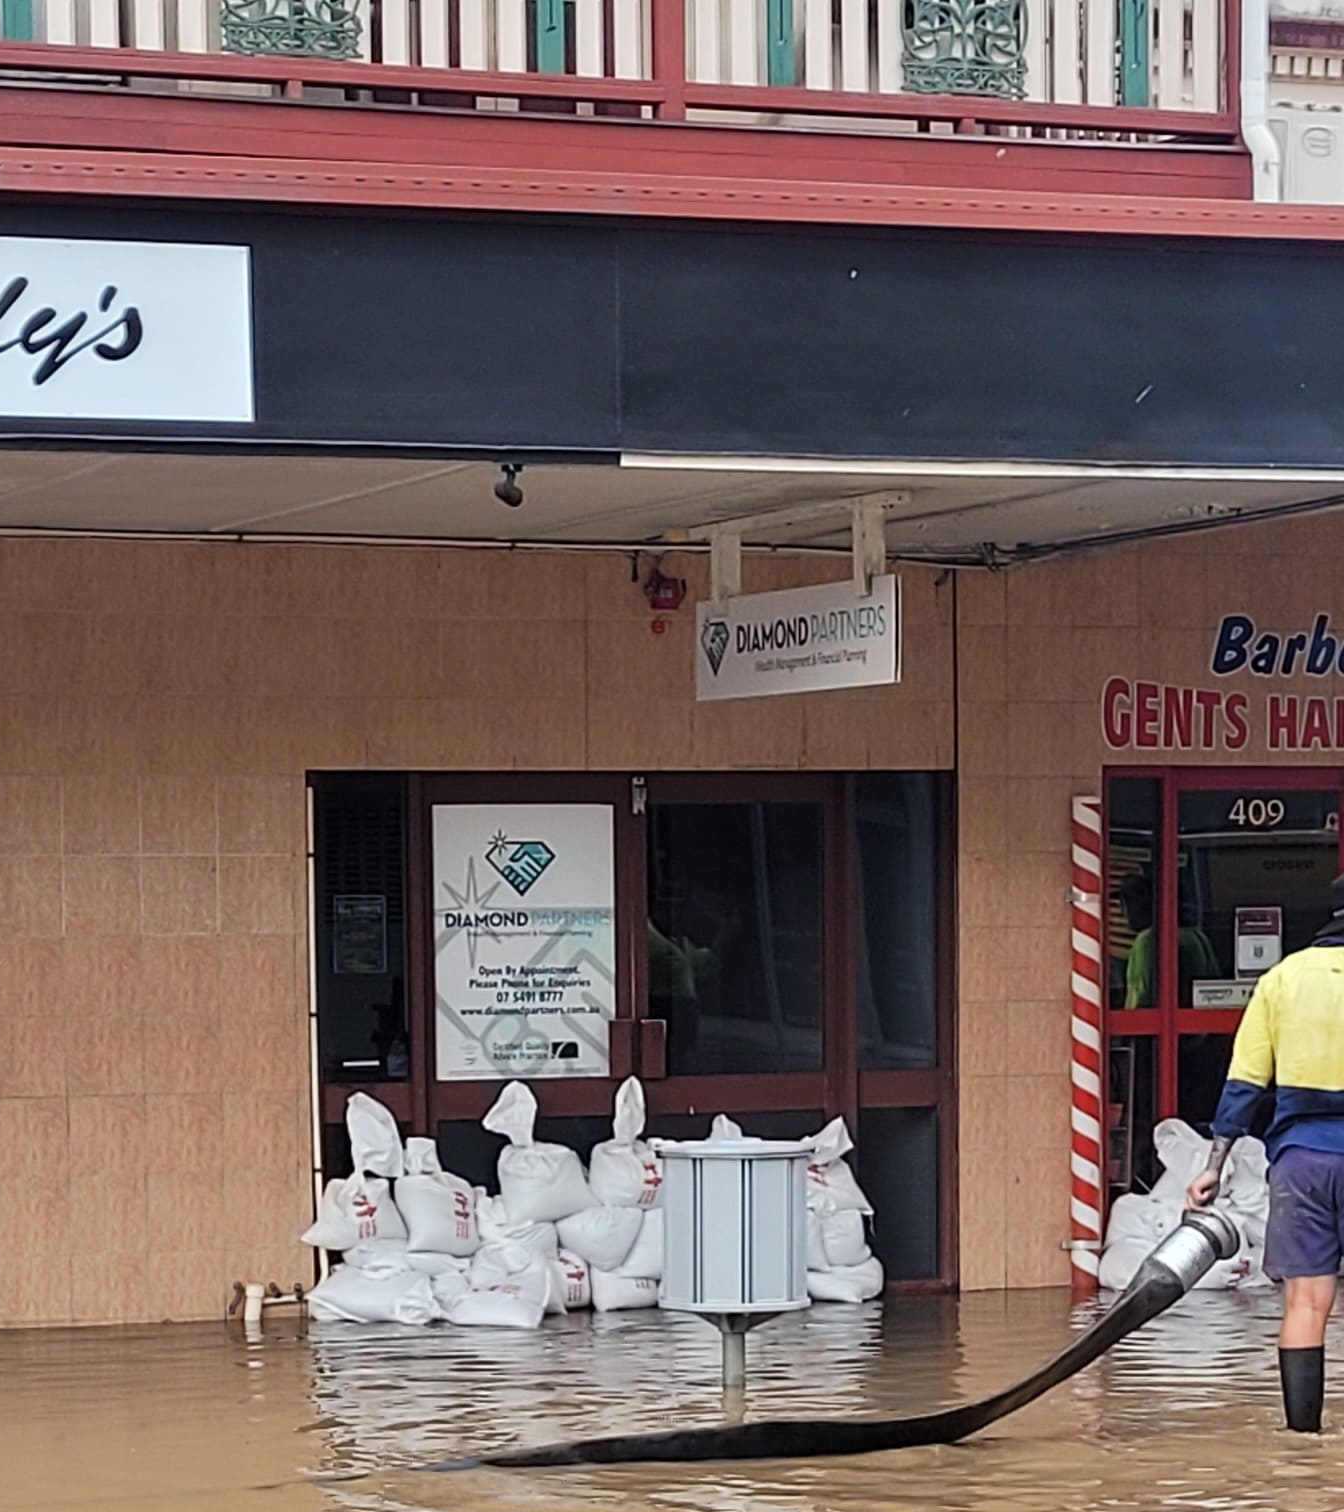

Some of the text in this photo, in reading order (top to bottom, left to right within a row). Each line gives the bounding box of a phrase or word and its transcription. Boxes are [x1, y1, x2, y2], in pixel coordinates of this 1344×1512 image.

[1102, 678, 1250, 749] GENTS
[1228, 797, 1286, 827] 409
[478, 965, 502, 977] Open
[505, 965, 517, 977] By
[469, 978, 591, 991] Please Phone for Enquiries
[496, 991, 509, 1003] 07
[512, 991, 536, 1003] 5491
